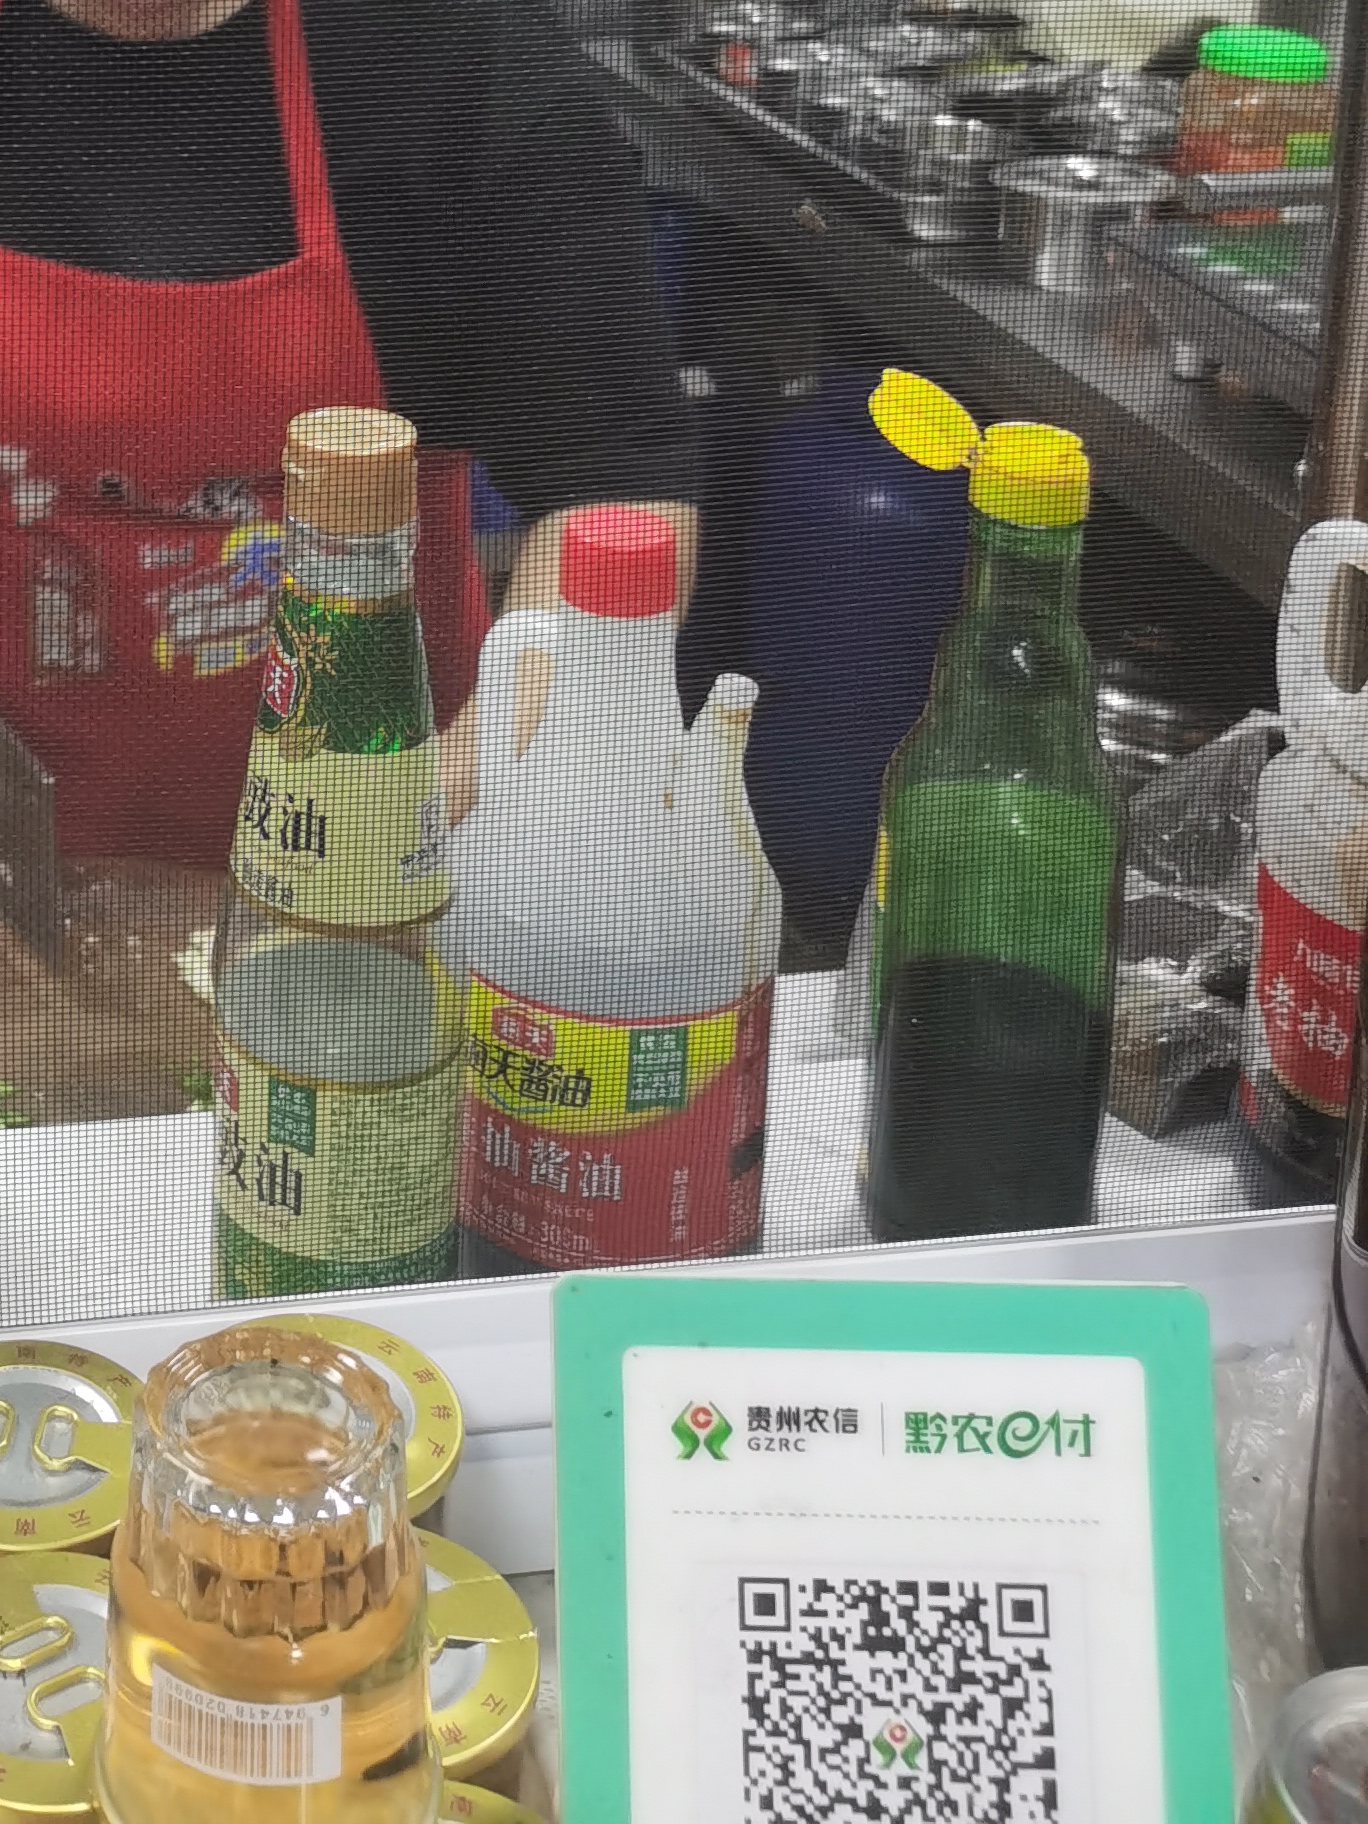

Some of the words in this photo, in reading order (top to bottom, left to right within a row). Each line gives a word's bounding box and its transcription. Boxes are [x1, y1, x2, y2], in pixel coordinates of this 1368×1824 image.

[747, 1406, 859, 1434] 贵州农信
[747, 1437, 807, 1453] GZRC
